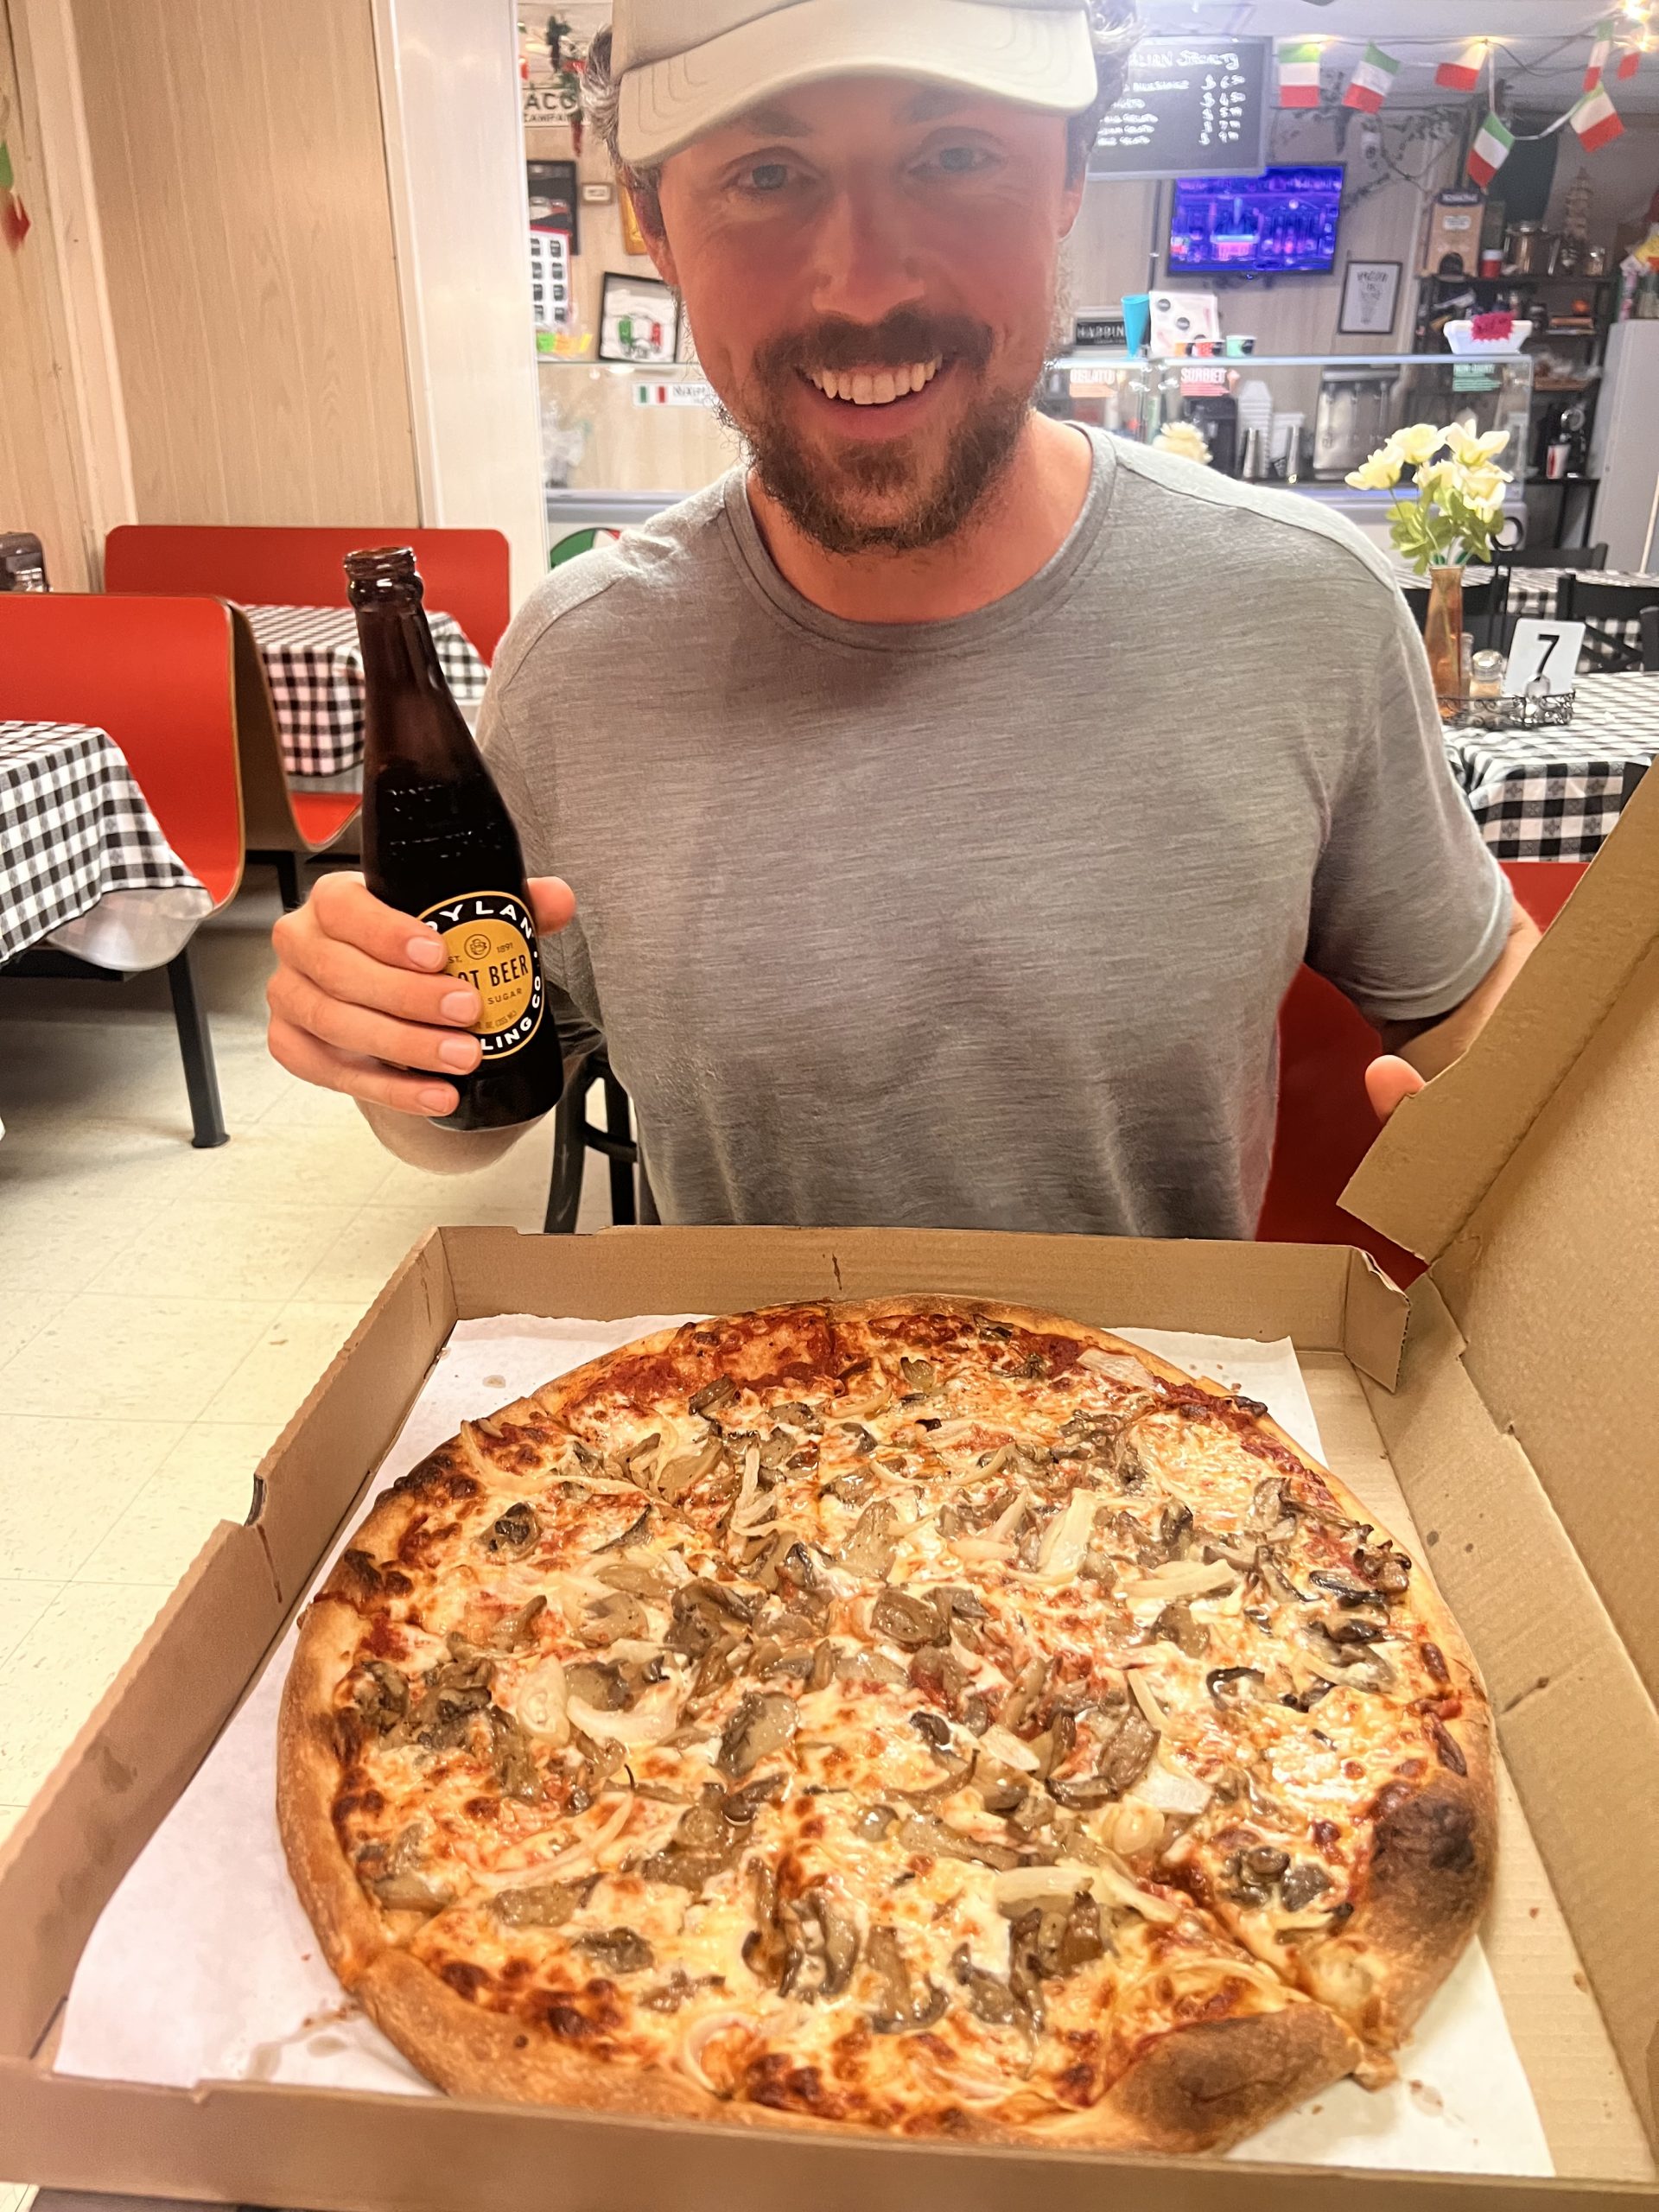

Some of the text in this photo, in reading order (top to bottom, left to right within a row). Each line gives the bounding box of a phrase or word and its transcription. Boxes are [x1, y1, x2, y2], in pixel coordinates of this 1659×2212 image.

[1537, 634, 1560, 682] 7
[496, 942, 514, 954] 1891
[446, 954, 530, 991] OT BEER
[487, 988, 522, 1005] SUGAR
